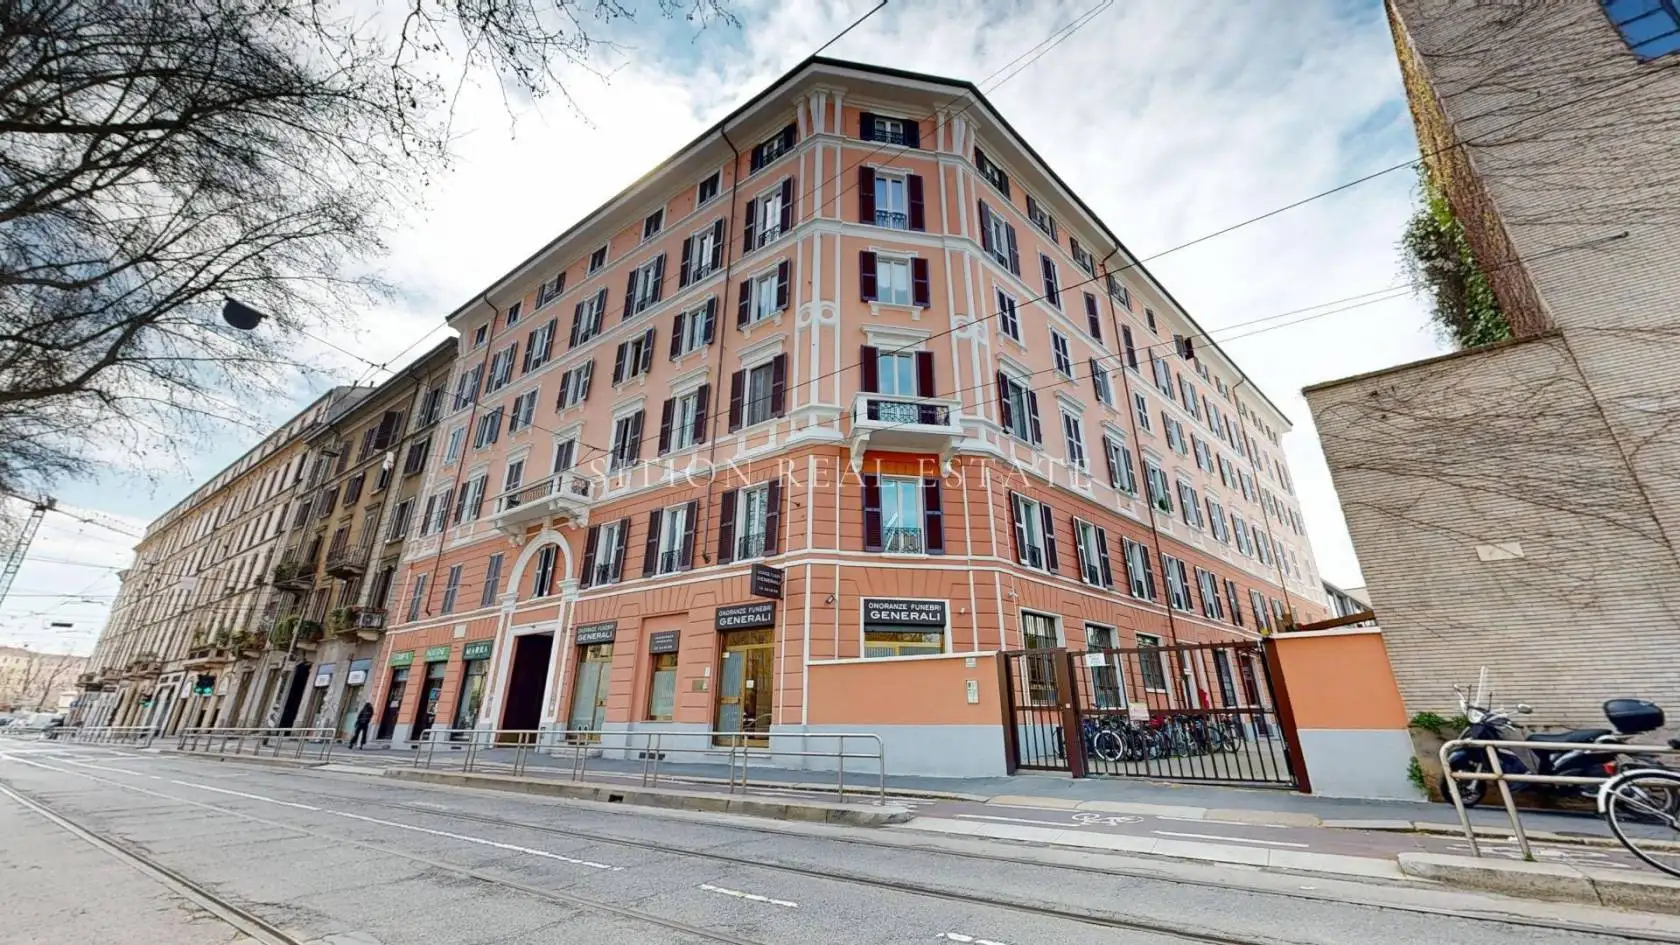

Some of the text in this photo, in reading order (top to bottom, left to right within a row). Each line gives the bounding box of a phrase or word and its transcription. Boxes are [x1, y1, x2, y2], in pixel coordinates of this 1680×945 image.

[868, 602, 942, 611] ONORANZE FUNEBRI
[719, 613, 771, 626] GENERALI
[870, 610, 940, 621] GENERALI
[577, 631, 613, 641] GENERALI
